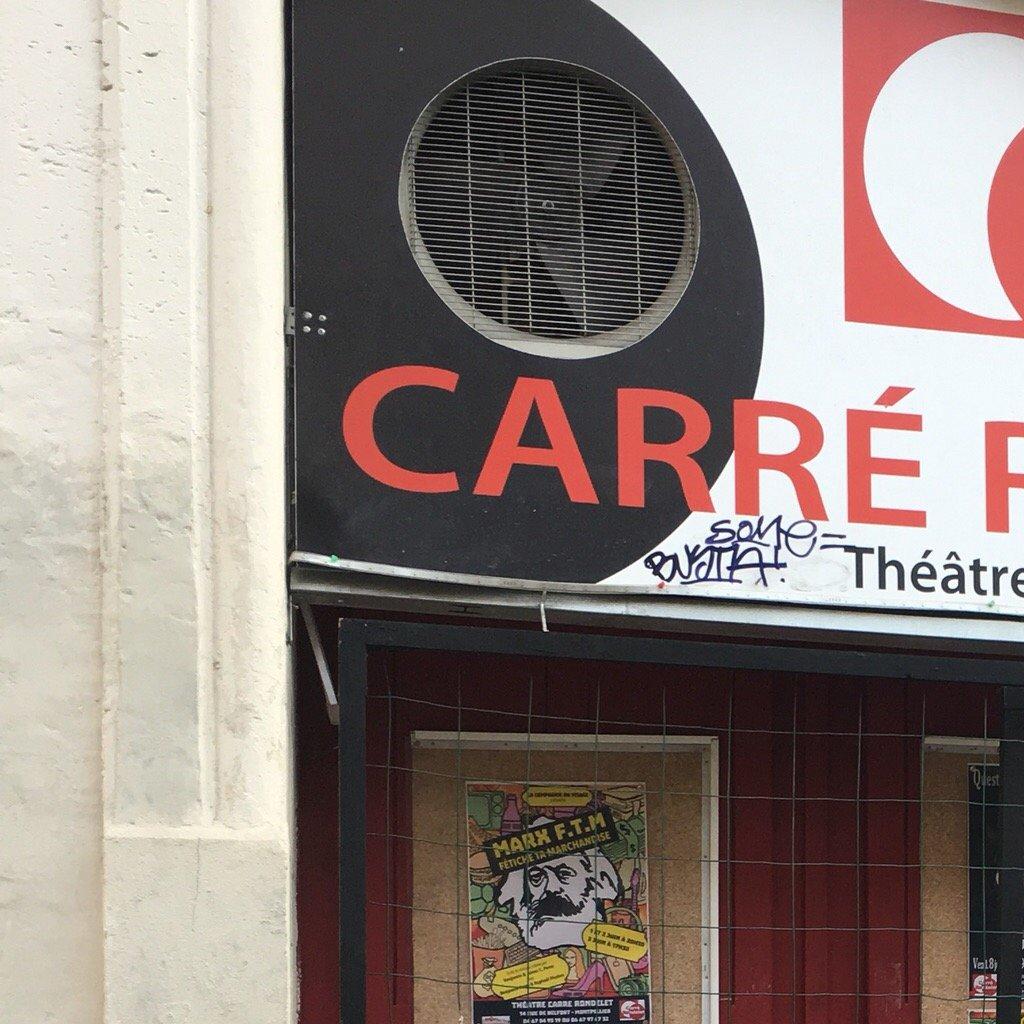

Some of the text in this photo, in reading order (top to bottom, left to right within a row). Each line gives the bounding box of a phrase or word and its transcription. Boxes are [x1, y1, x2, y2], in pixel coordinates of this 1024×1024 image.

[342, 364, 928, 530] CARRÉ
[492, 812, 607, 858] MARX F.T.M
[547, 831, 612, 857] MARCHANDISE
